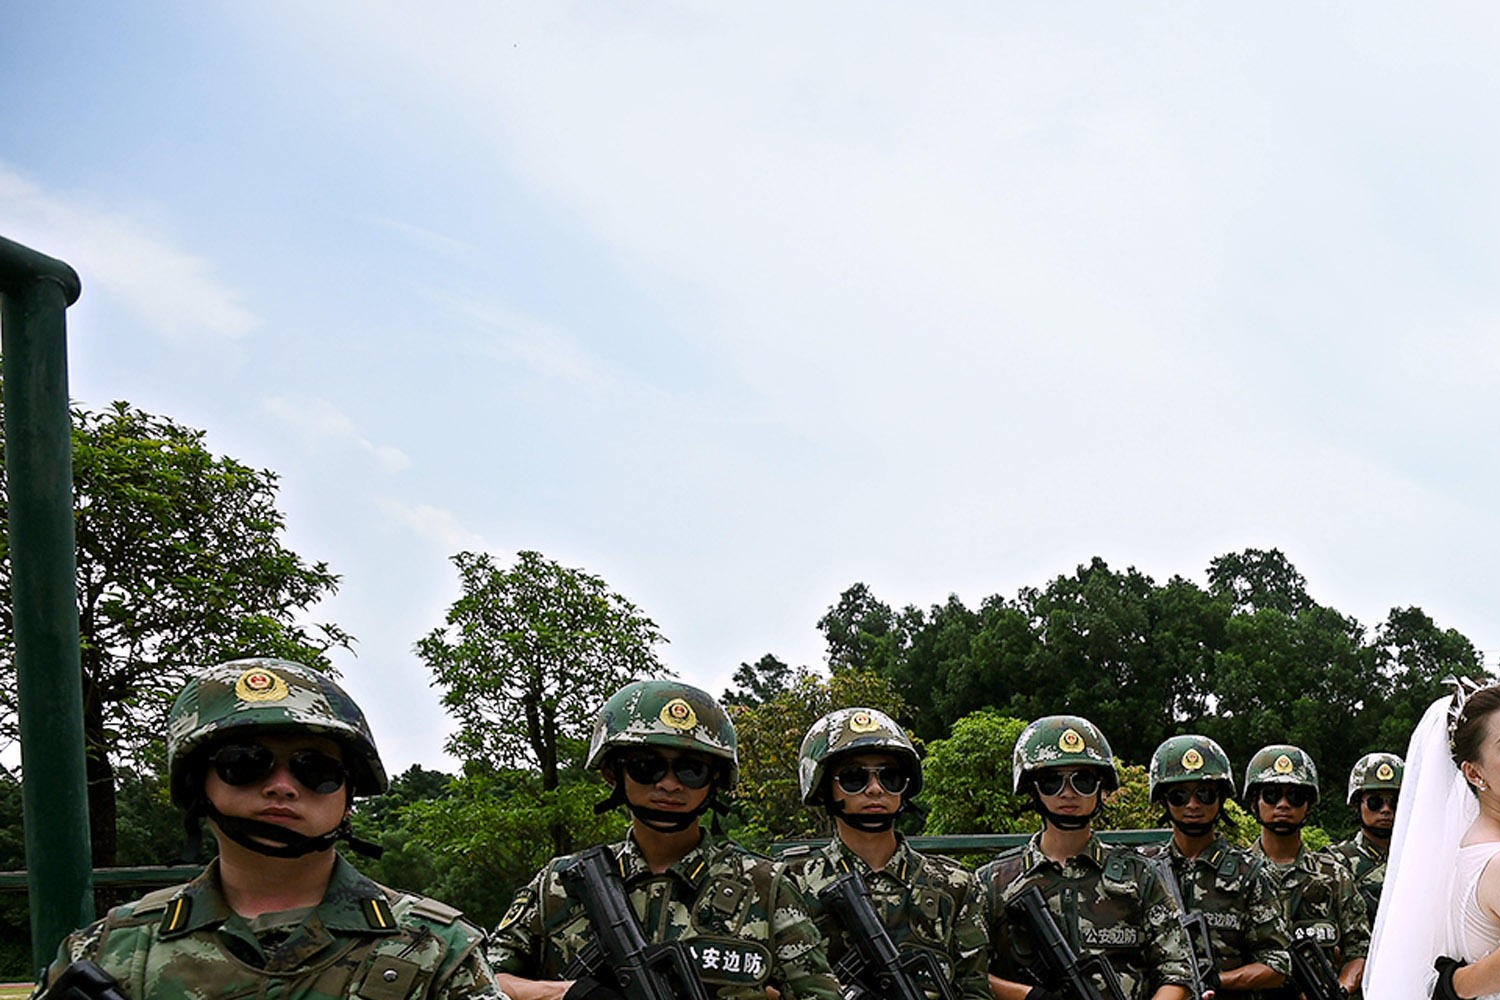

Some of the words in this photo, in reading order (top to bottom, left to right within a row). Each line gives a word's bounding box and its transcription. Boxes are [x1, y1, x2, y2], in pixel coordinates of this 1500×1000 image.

[1085, 927, 1137, 945] 公安边防
[689, 946, 763, 974] 安边防
